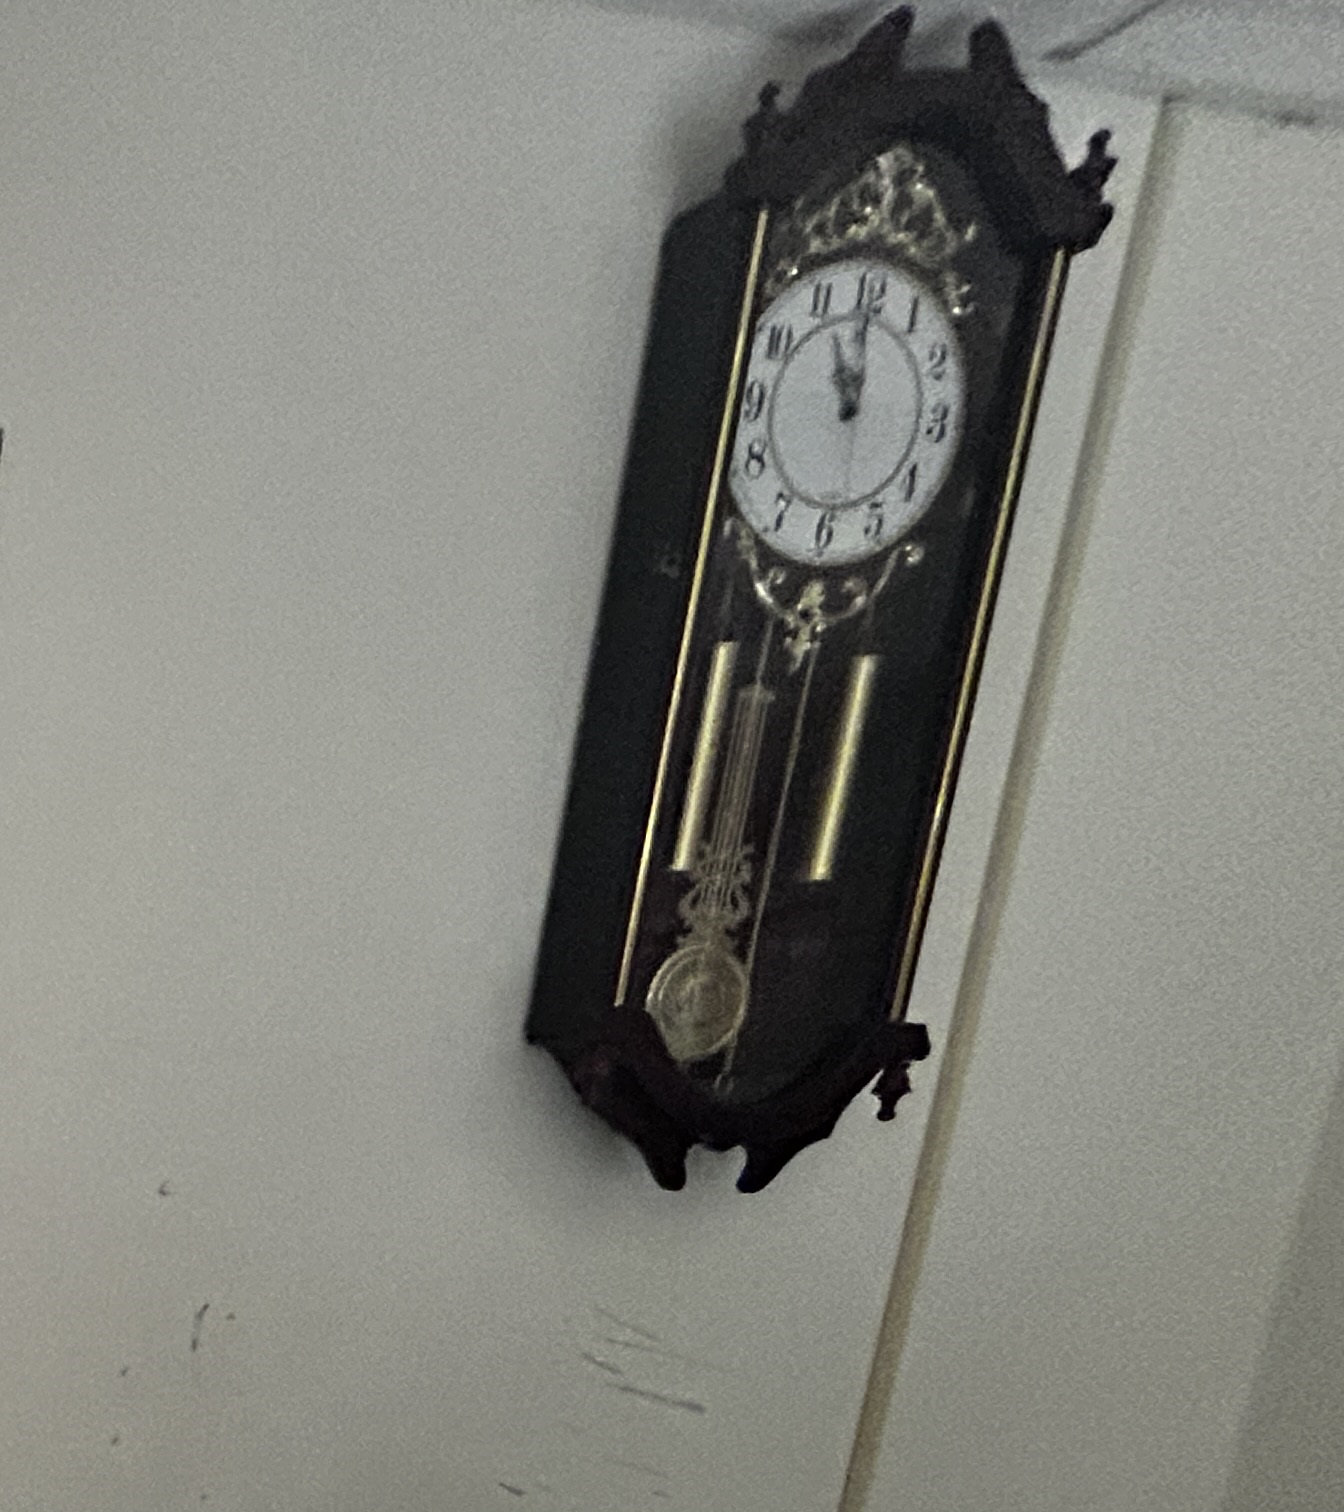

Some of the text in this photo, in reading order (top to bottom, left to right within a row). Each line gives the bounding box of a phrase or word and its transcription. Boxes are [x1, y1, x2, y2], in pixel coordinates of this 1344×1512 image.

[810, 281, 833, 318] 11
[908, 295, 919, 333] 1
[766, 323, 793, 361] 10
[928, 342, 948, 381] 2
[743, 379, 766, 423] 9
[926, 402, 950, 443] 3
[744, 438, 766, 480] 8
[773, 491, 791, 532] 7
[815, 510, 835, 549] 6
[863, 501, 884, 538] 5
